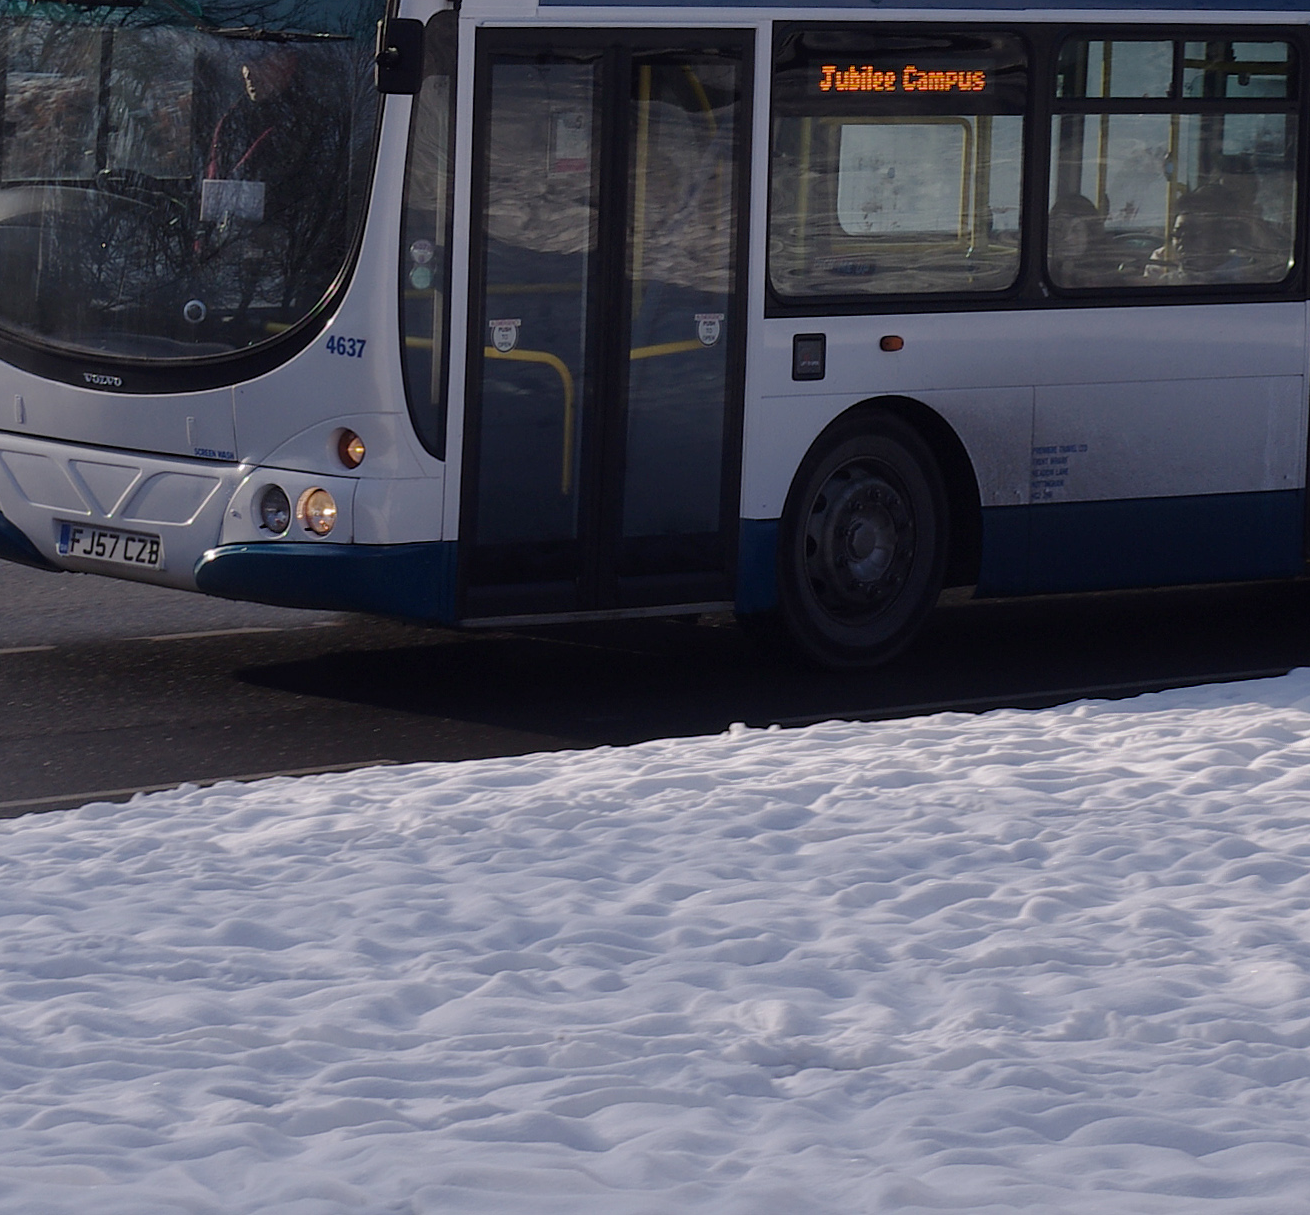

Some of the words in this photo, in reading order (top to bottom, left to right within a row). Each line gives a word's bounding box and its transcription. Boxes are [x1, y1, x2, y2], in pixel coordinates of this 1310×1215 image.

[819, 65, 897, 92] Jubilee
[902, 65, 986, 92] Campus
[326, 335, 367, 358] 4637
[82, 372, 122, 387] VOLVO
[194, 448, 216, 457] SCREEN
[217, 451, 235, 459] WASH
[70, 528, 120, 558] FJ57
[123, 536, 160, 565] CZB
